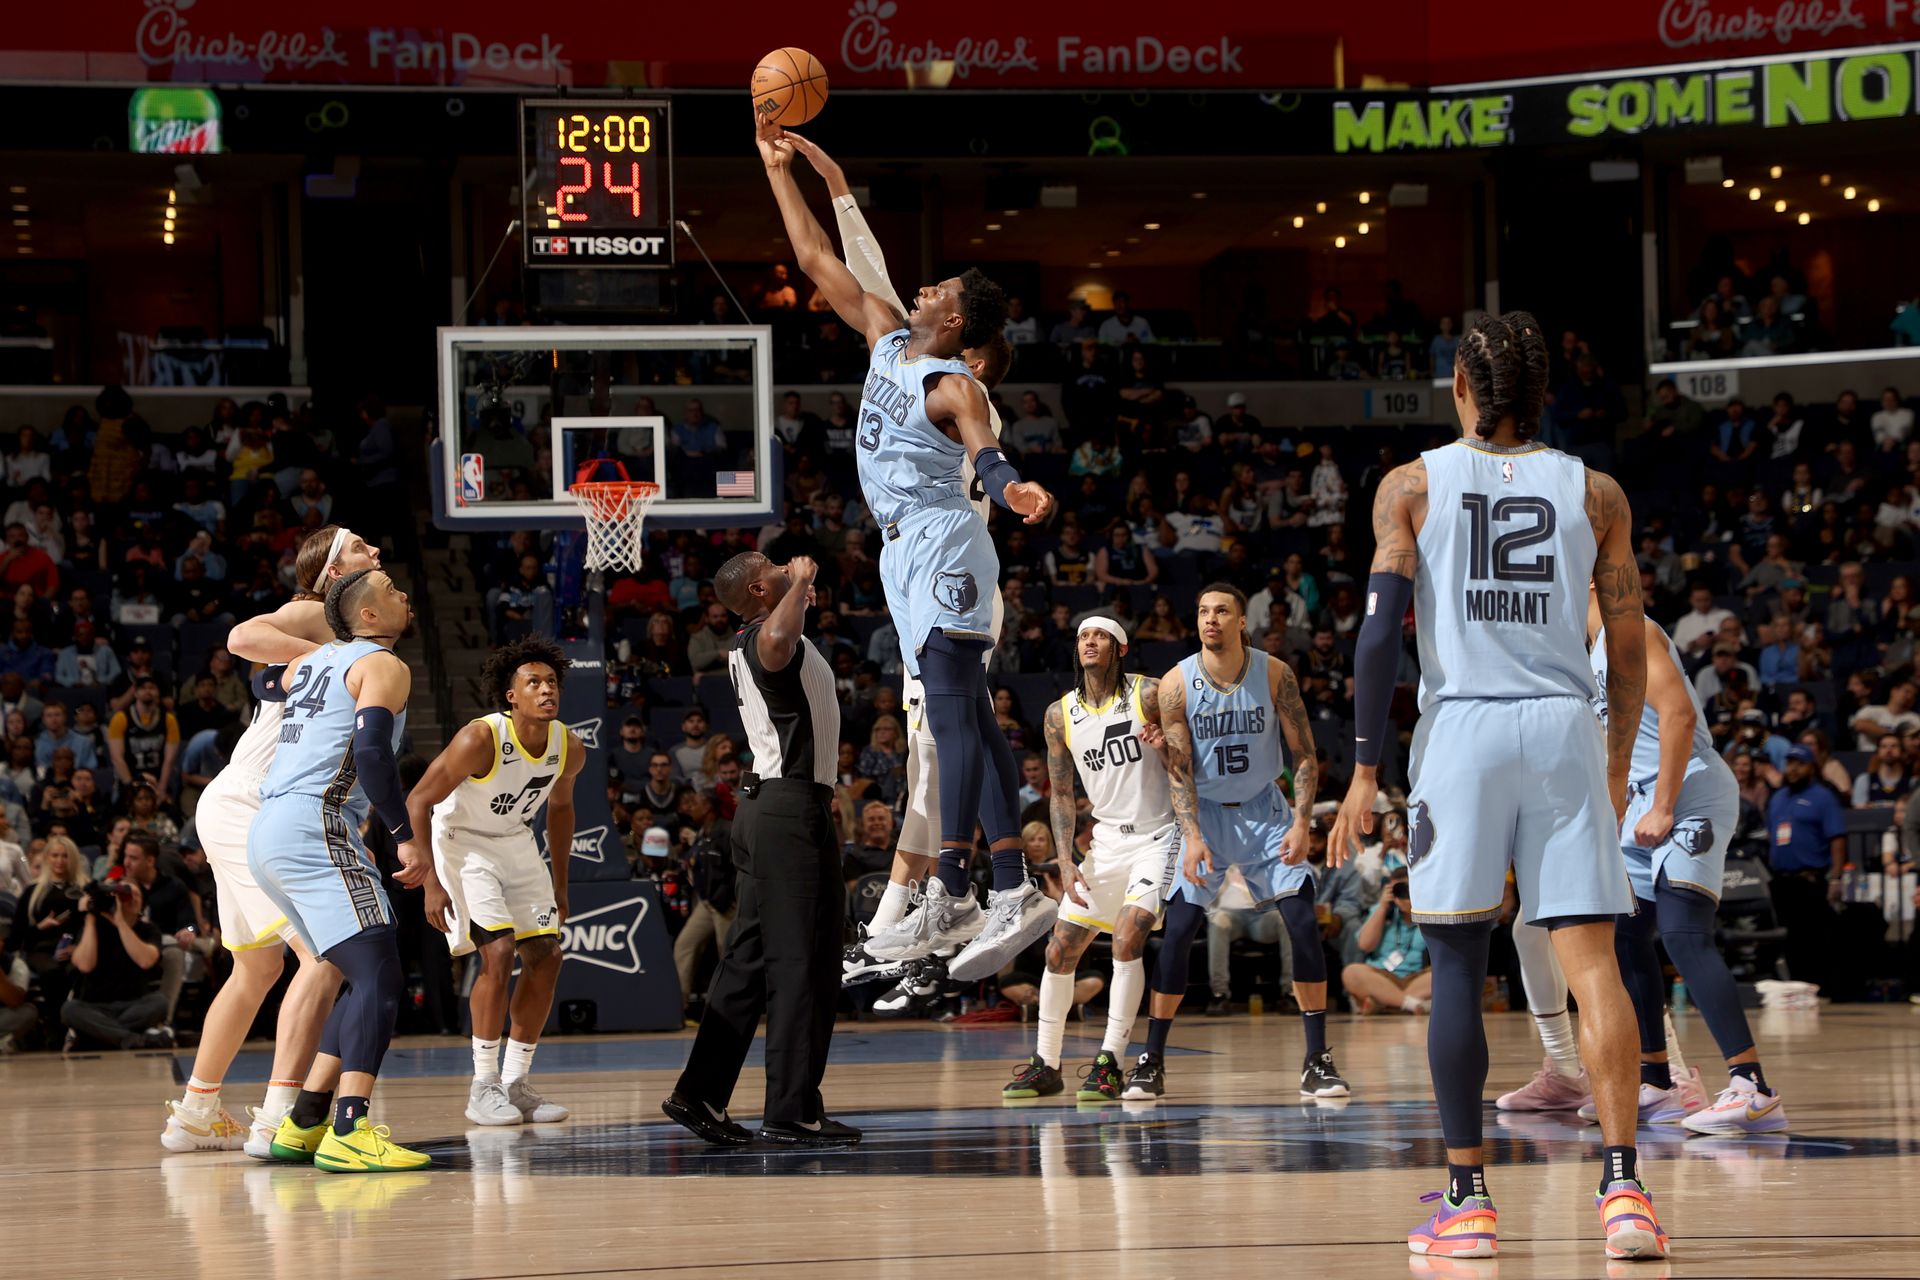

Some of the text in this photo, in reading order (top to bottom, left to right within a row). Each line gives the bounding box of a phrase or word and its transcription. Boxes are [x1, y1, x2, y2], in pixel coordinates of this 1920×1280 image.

[136, 4, 565, 71] Chick-fil-A FanDeck
[841, 13, 1244, 79] Chick-fil-A FanDeck
[1332, 49, 1920, 153] MAKE SOME NO
[557, 114, 651, 153] 12:00
[555, 156, 641, 221] 24
[569, 236, 665, 255] TISSOT
[1689, 373, 1727, 397] 108
[1384, 394, 1418, 413] 109
[1462, 492, 1556, 582] 12
[1465, 590, 1550, 624] MORANT
[282, 665, 334, 720] 24
[1194, 706, 1264, 740] GRIZZLIES
[1106, 735, 1142, 767] 00
[1213, 744, 1250, 776] 15
[521, 789, 541, 815] 2
[570, 838, 597, 852] NIC
[560, 923, 627, 952] ONIC
